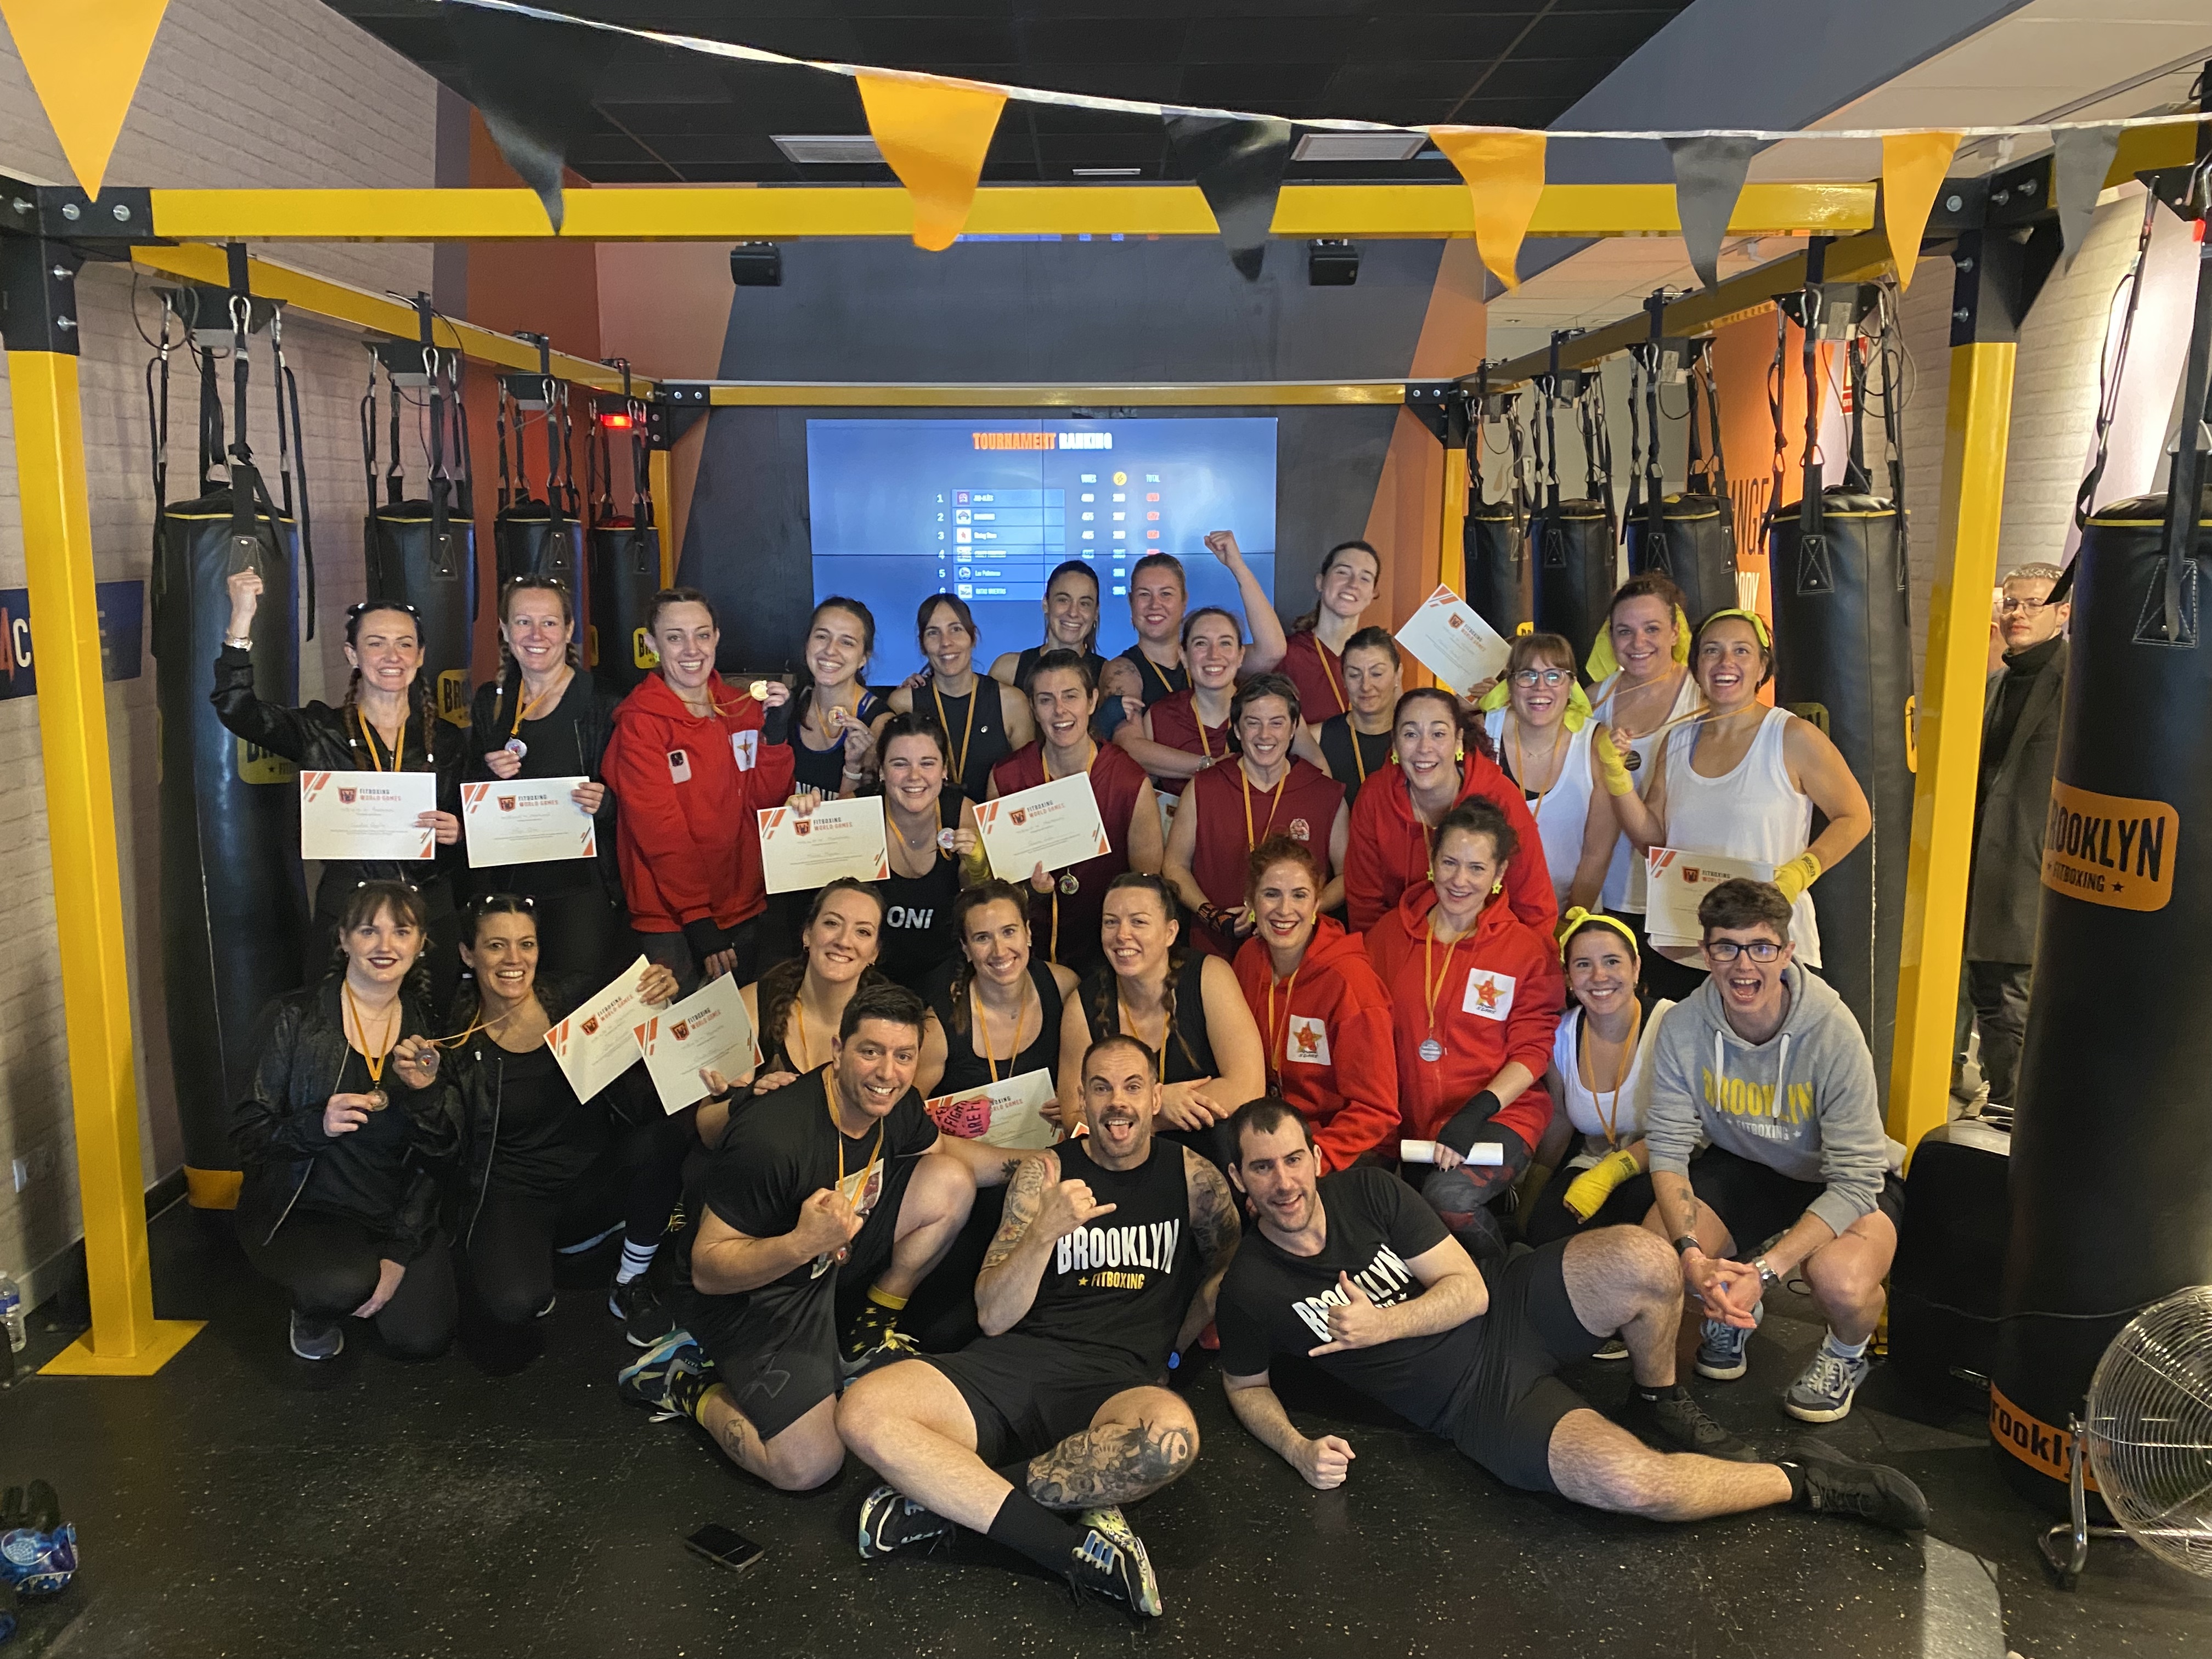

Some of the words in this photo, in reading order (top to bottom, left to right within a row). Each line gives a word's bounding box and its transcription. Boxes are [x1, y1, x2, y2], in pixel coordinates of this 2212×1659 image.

[973, 432, 1056, 450] TOURNAMENT
[936, 494, 944, 503] 1
[937, 513, 944, 521] 2
[938, 532, 944, 540] 3
[938, 549, 945, 560] 4
[939, 569, 946, 578] 5
[1735, 571, 1760, 612] ODY
[1027, 800, 1053, 812] FITBOXING
[1029, 809, 1047, 818] WORLD
[2049, 799, 2165, 882] ROOKLYN
[992, 1096, 1011, 1105] OXING
[1703, 1065, 1813, 1124] BROOKYN
[991, 1103, 1003, 1111] ORLD
[1005, 1099, 1024, 1108] GAMES
[966, 1114, 984, 1134] ARE
[1736, 1120, 1790, 1141] FITBOXING
[1057, 1218, 1179, 1274] BROOKLYN
[1091, 1271, 1146, 1289] FITBOXING
[1993, 1400, 2094, 1479] rookl
